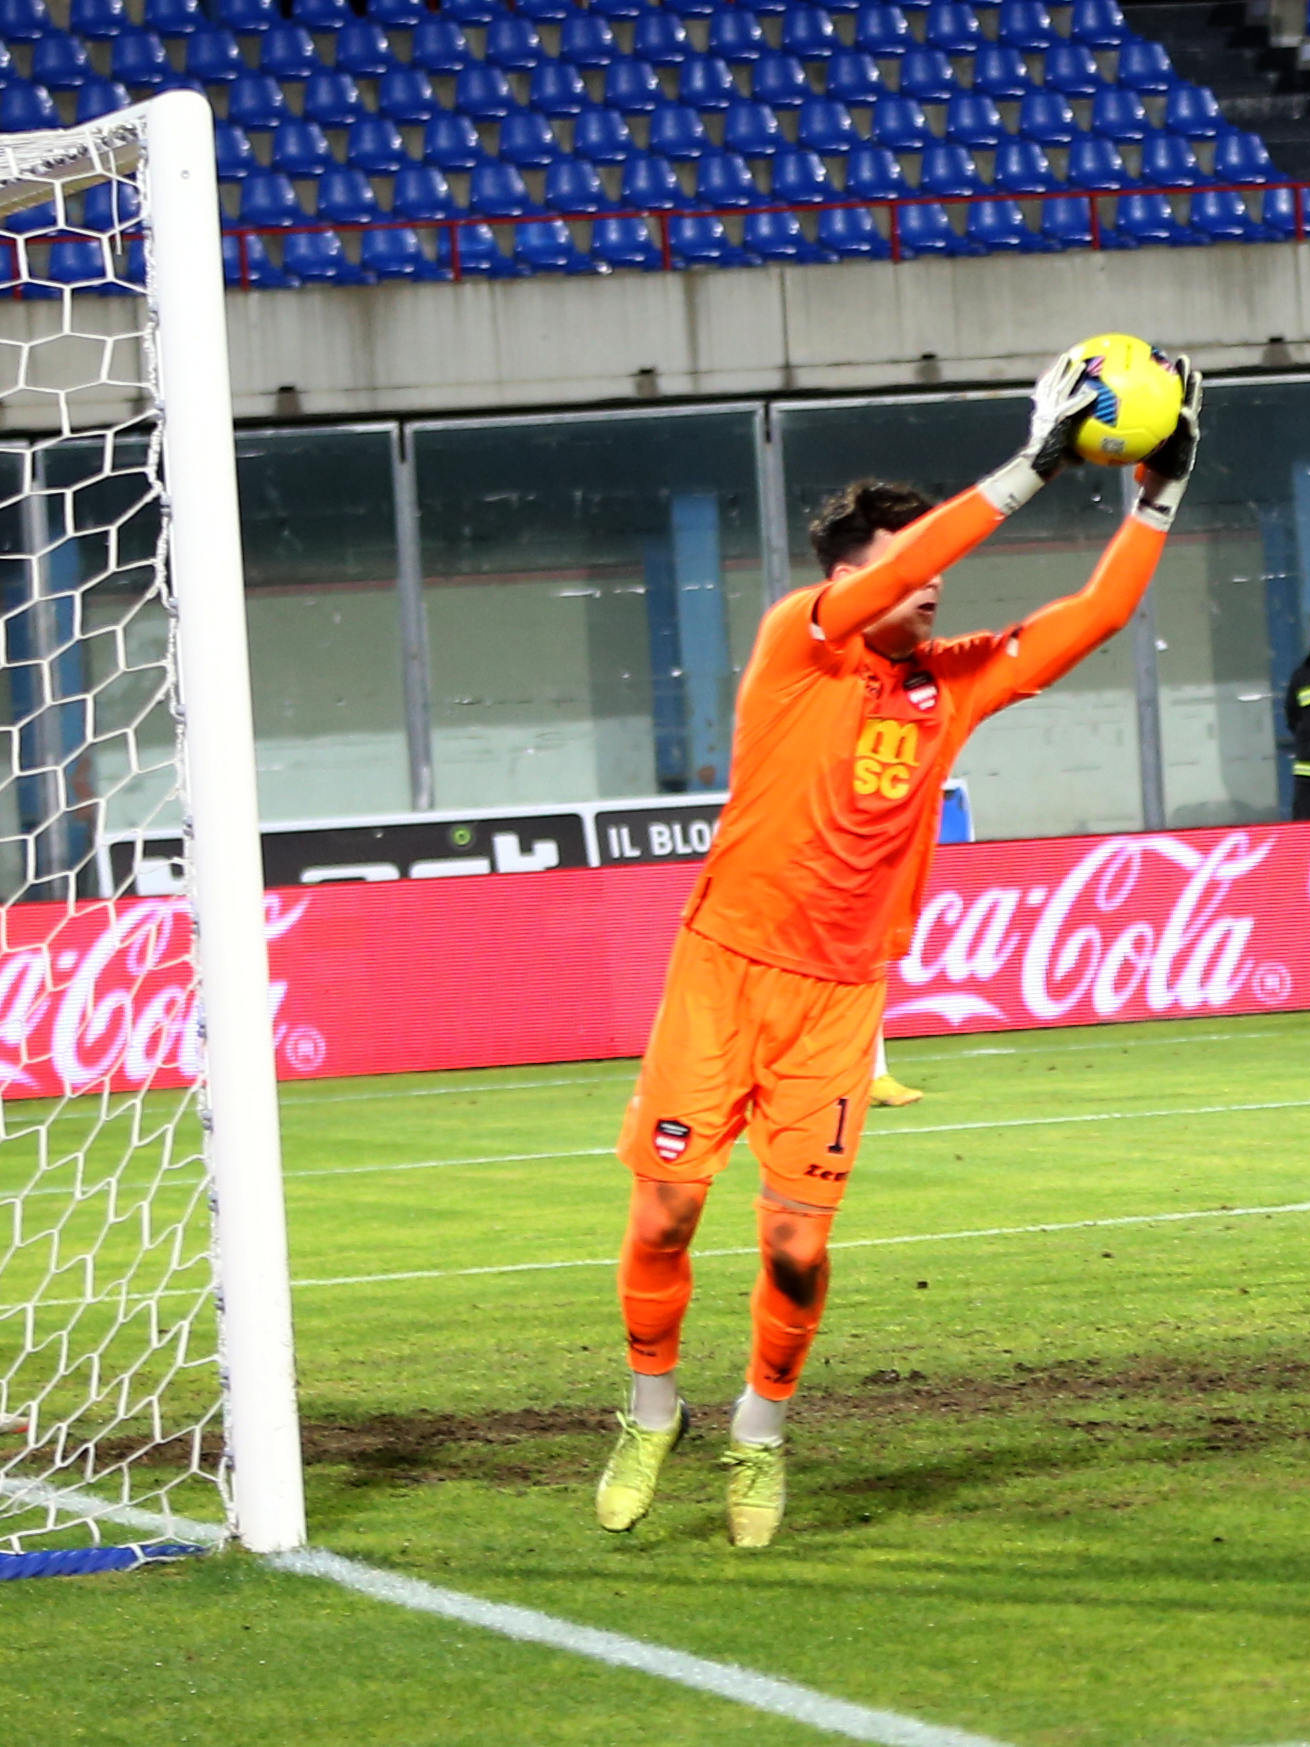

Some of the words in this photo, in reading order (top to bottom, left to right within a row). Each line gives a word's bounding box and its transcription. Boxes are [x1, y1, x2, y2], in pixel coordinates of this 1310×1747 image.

[608, 824, 641, 859] IL
[649, 820, 721, 856] BLO
[826, 1098, 849, 1155] 1
